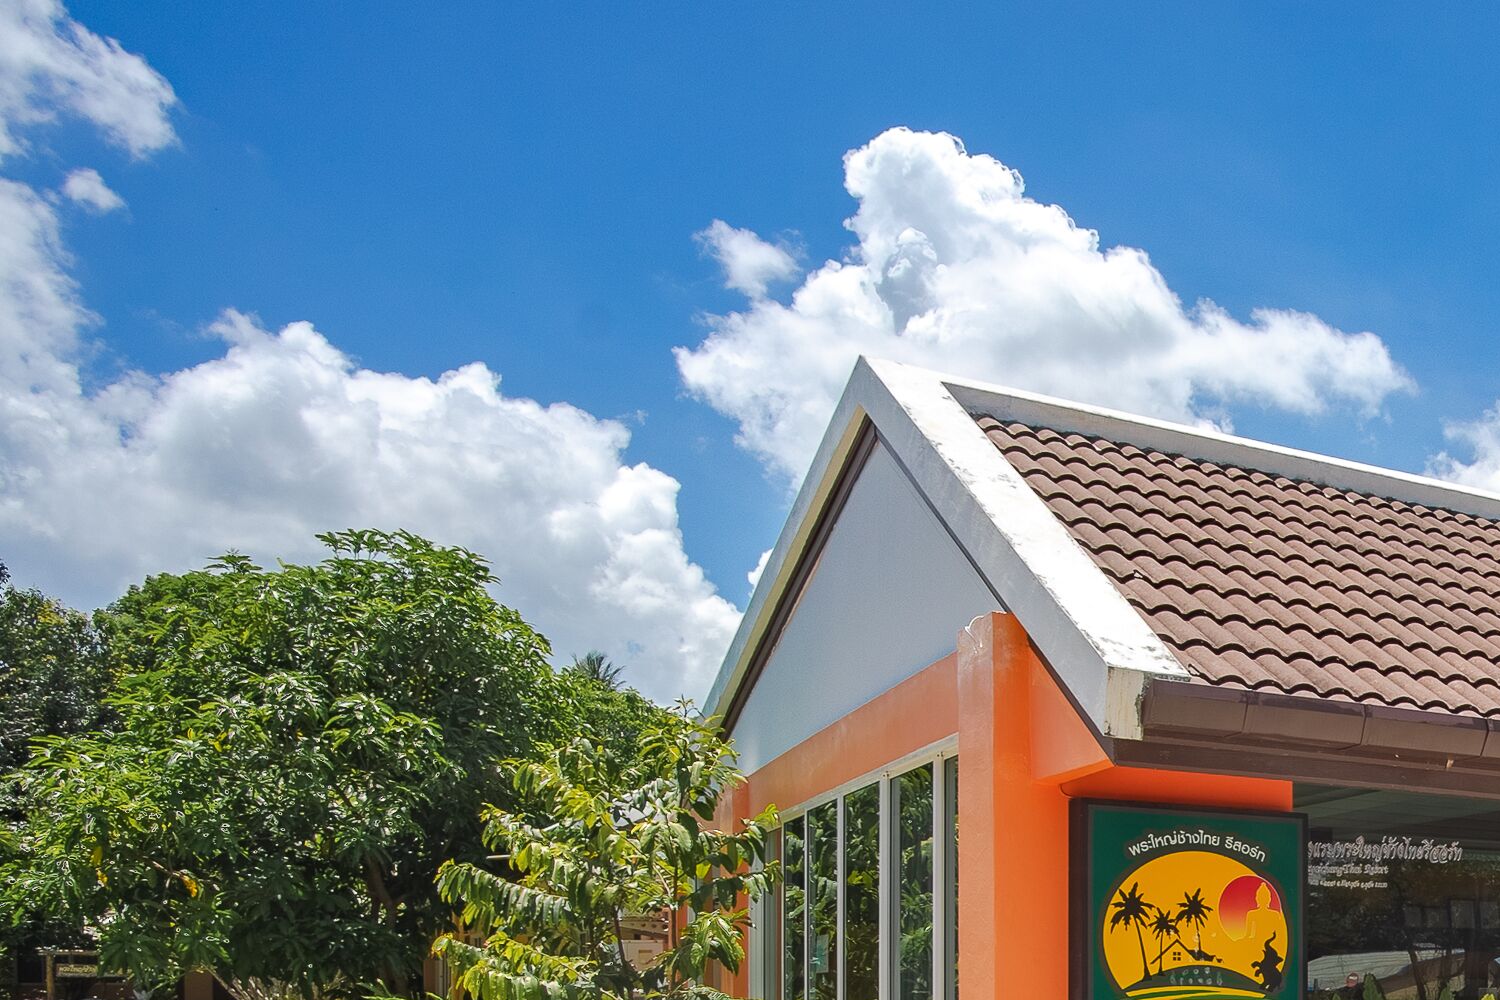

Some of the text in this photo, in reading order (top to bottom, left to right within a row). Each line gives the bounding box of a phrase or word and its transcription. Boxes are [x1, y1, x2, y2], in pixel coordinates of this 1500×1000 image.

[1128, 829, 1267, 863] พระใหญ่ช้างไทย รีสอร์ท
